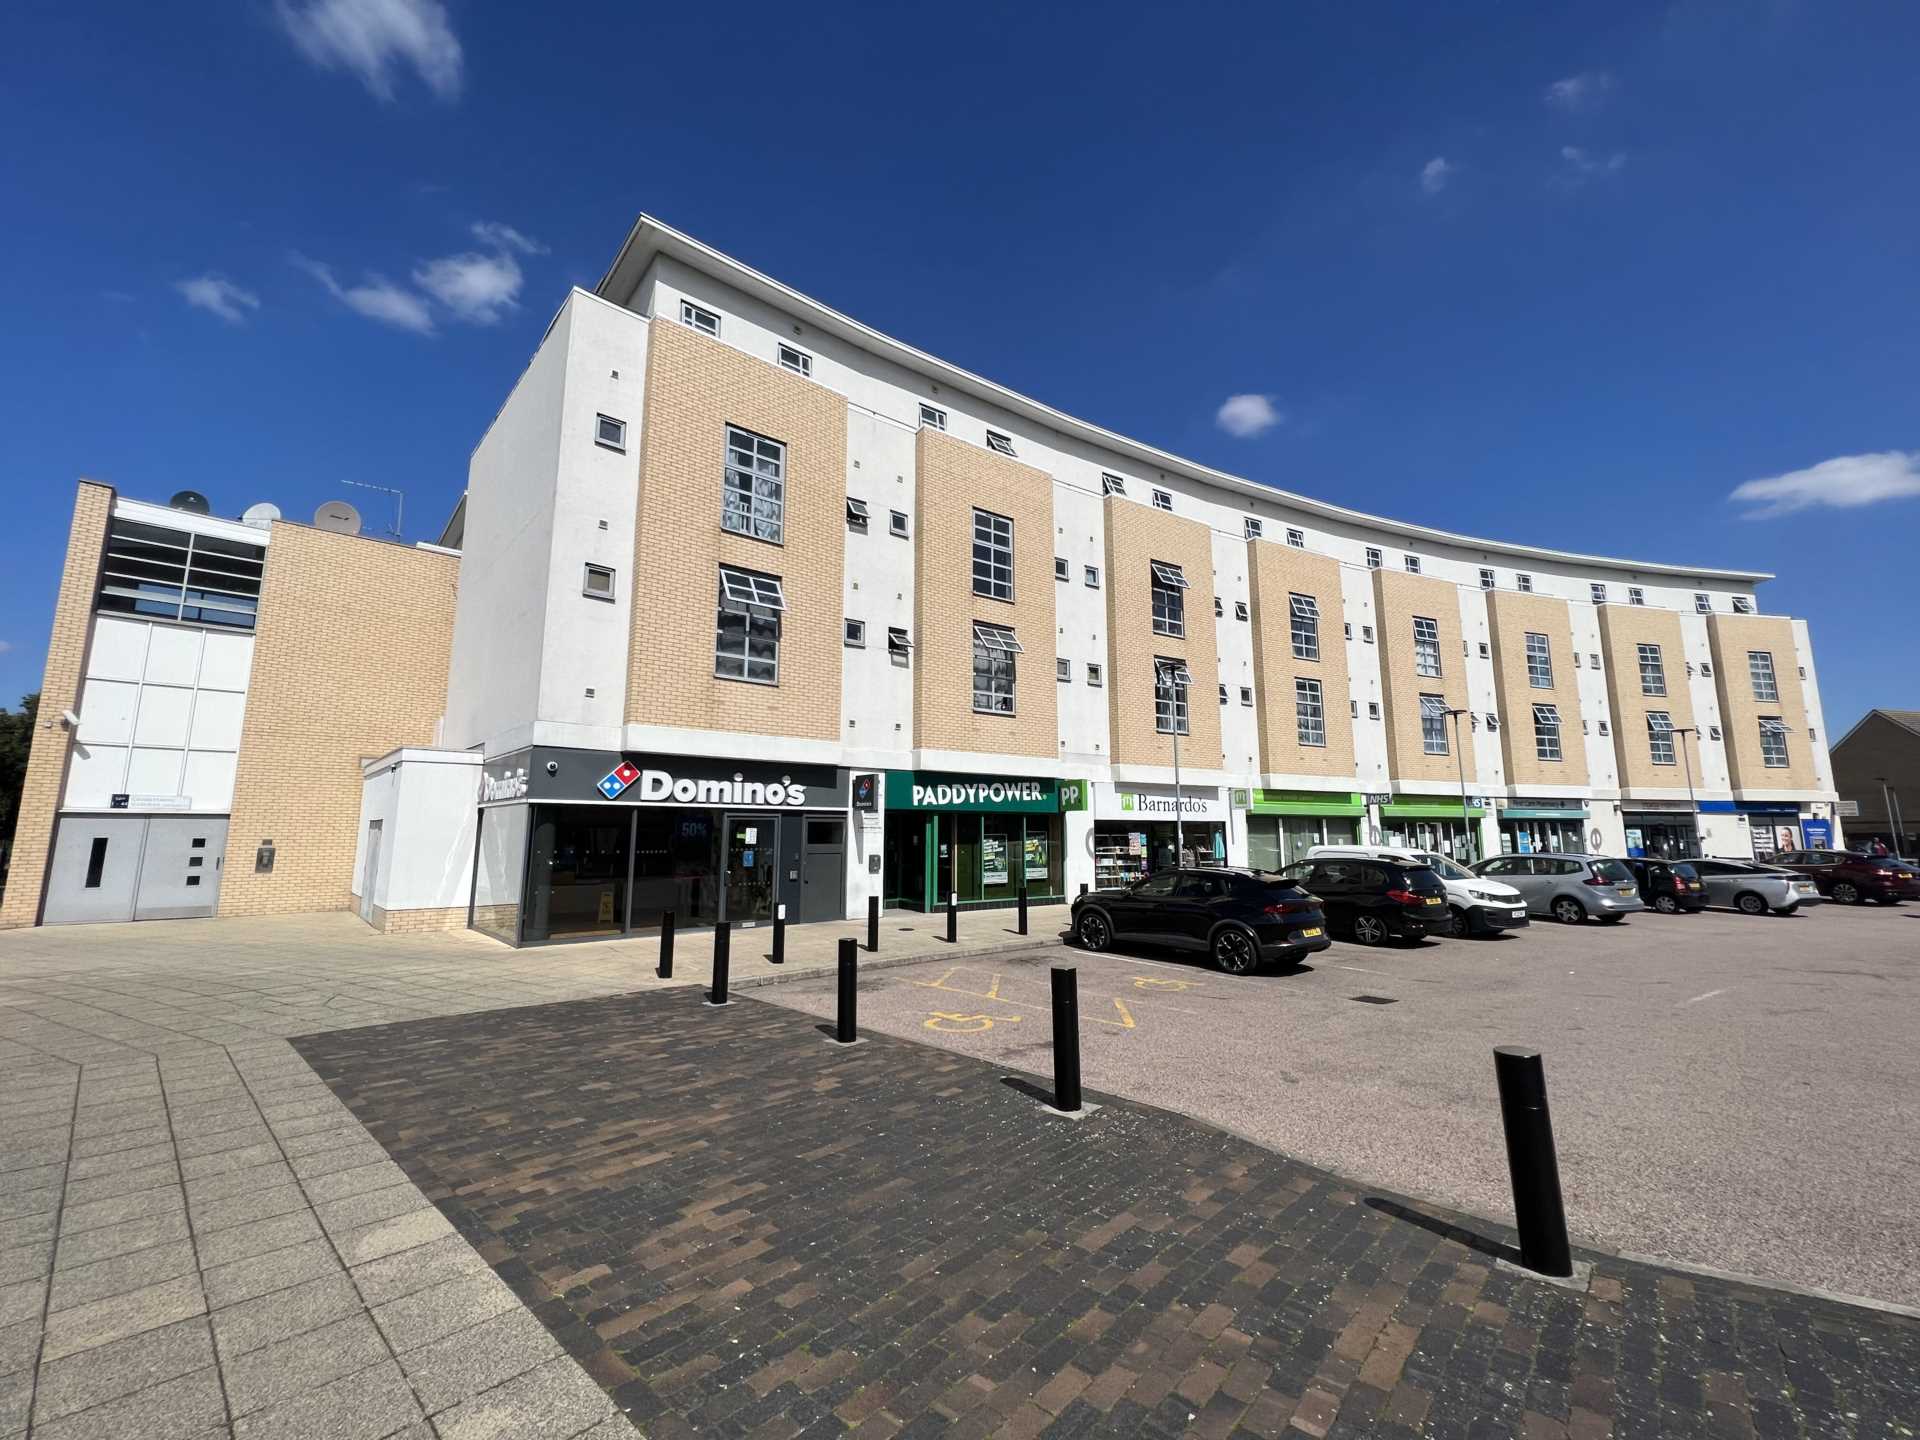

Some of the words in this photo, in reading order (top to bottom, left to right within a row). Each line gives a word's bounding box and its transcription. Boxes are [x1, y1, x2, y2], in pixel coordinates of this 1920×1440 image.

[640, 769, 807, 806] Domino's
[1138, 793, 1208, 813] Barnardo's
[1369, 794, 1389, 804] NHS
